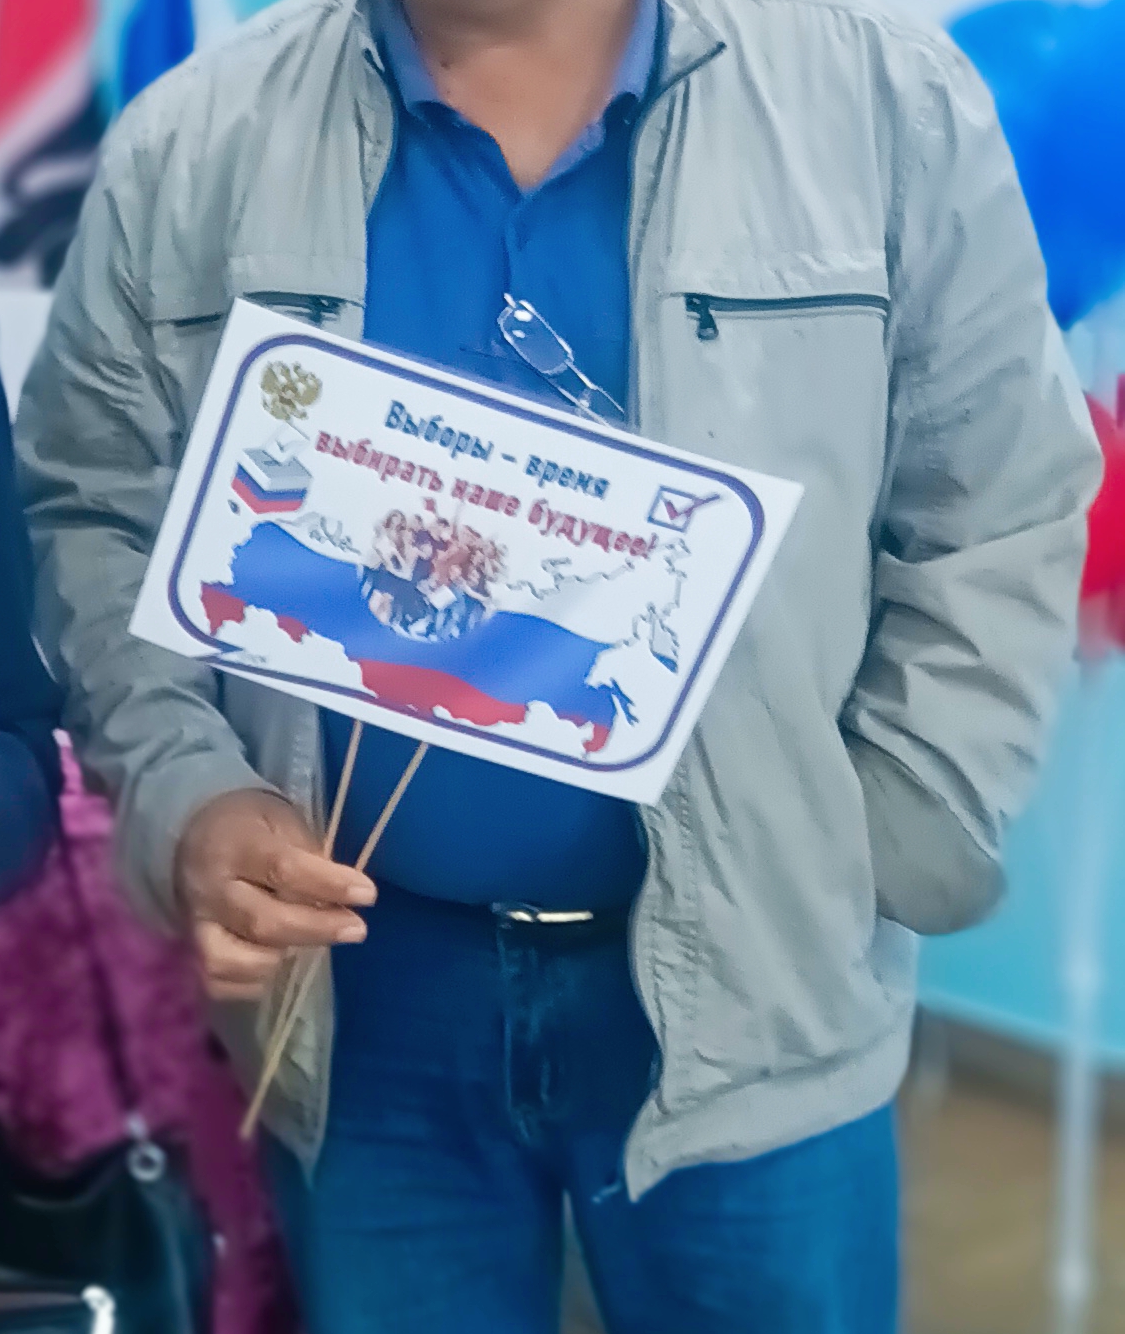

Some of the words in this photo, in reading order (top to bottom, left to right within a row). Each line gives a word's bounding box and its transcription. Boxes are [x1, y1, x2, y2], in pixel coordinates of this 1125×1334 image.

[315, 430, 444, 492] выбирать
[450, 476, 522, 518] наше
[527, 497, 659, 560] будущее!
[384, 399, 494, 462] Выборы
[525, 455, 610, 500] время
